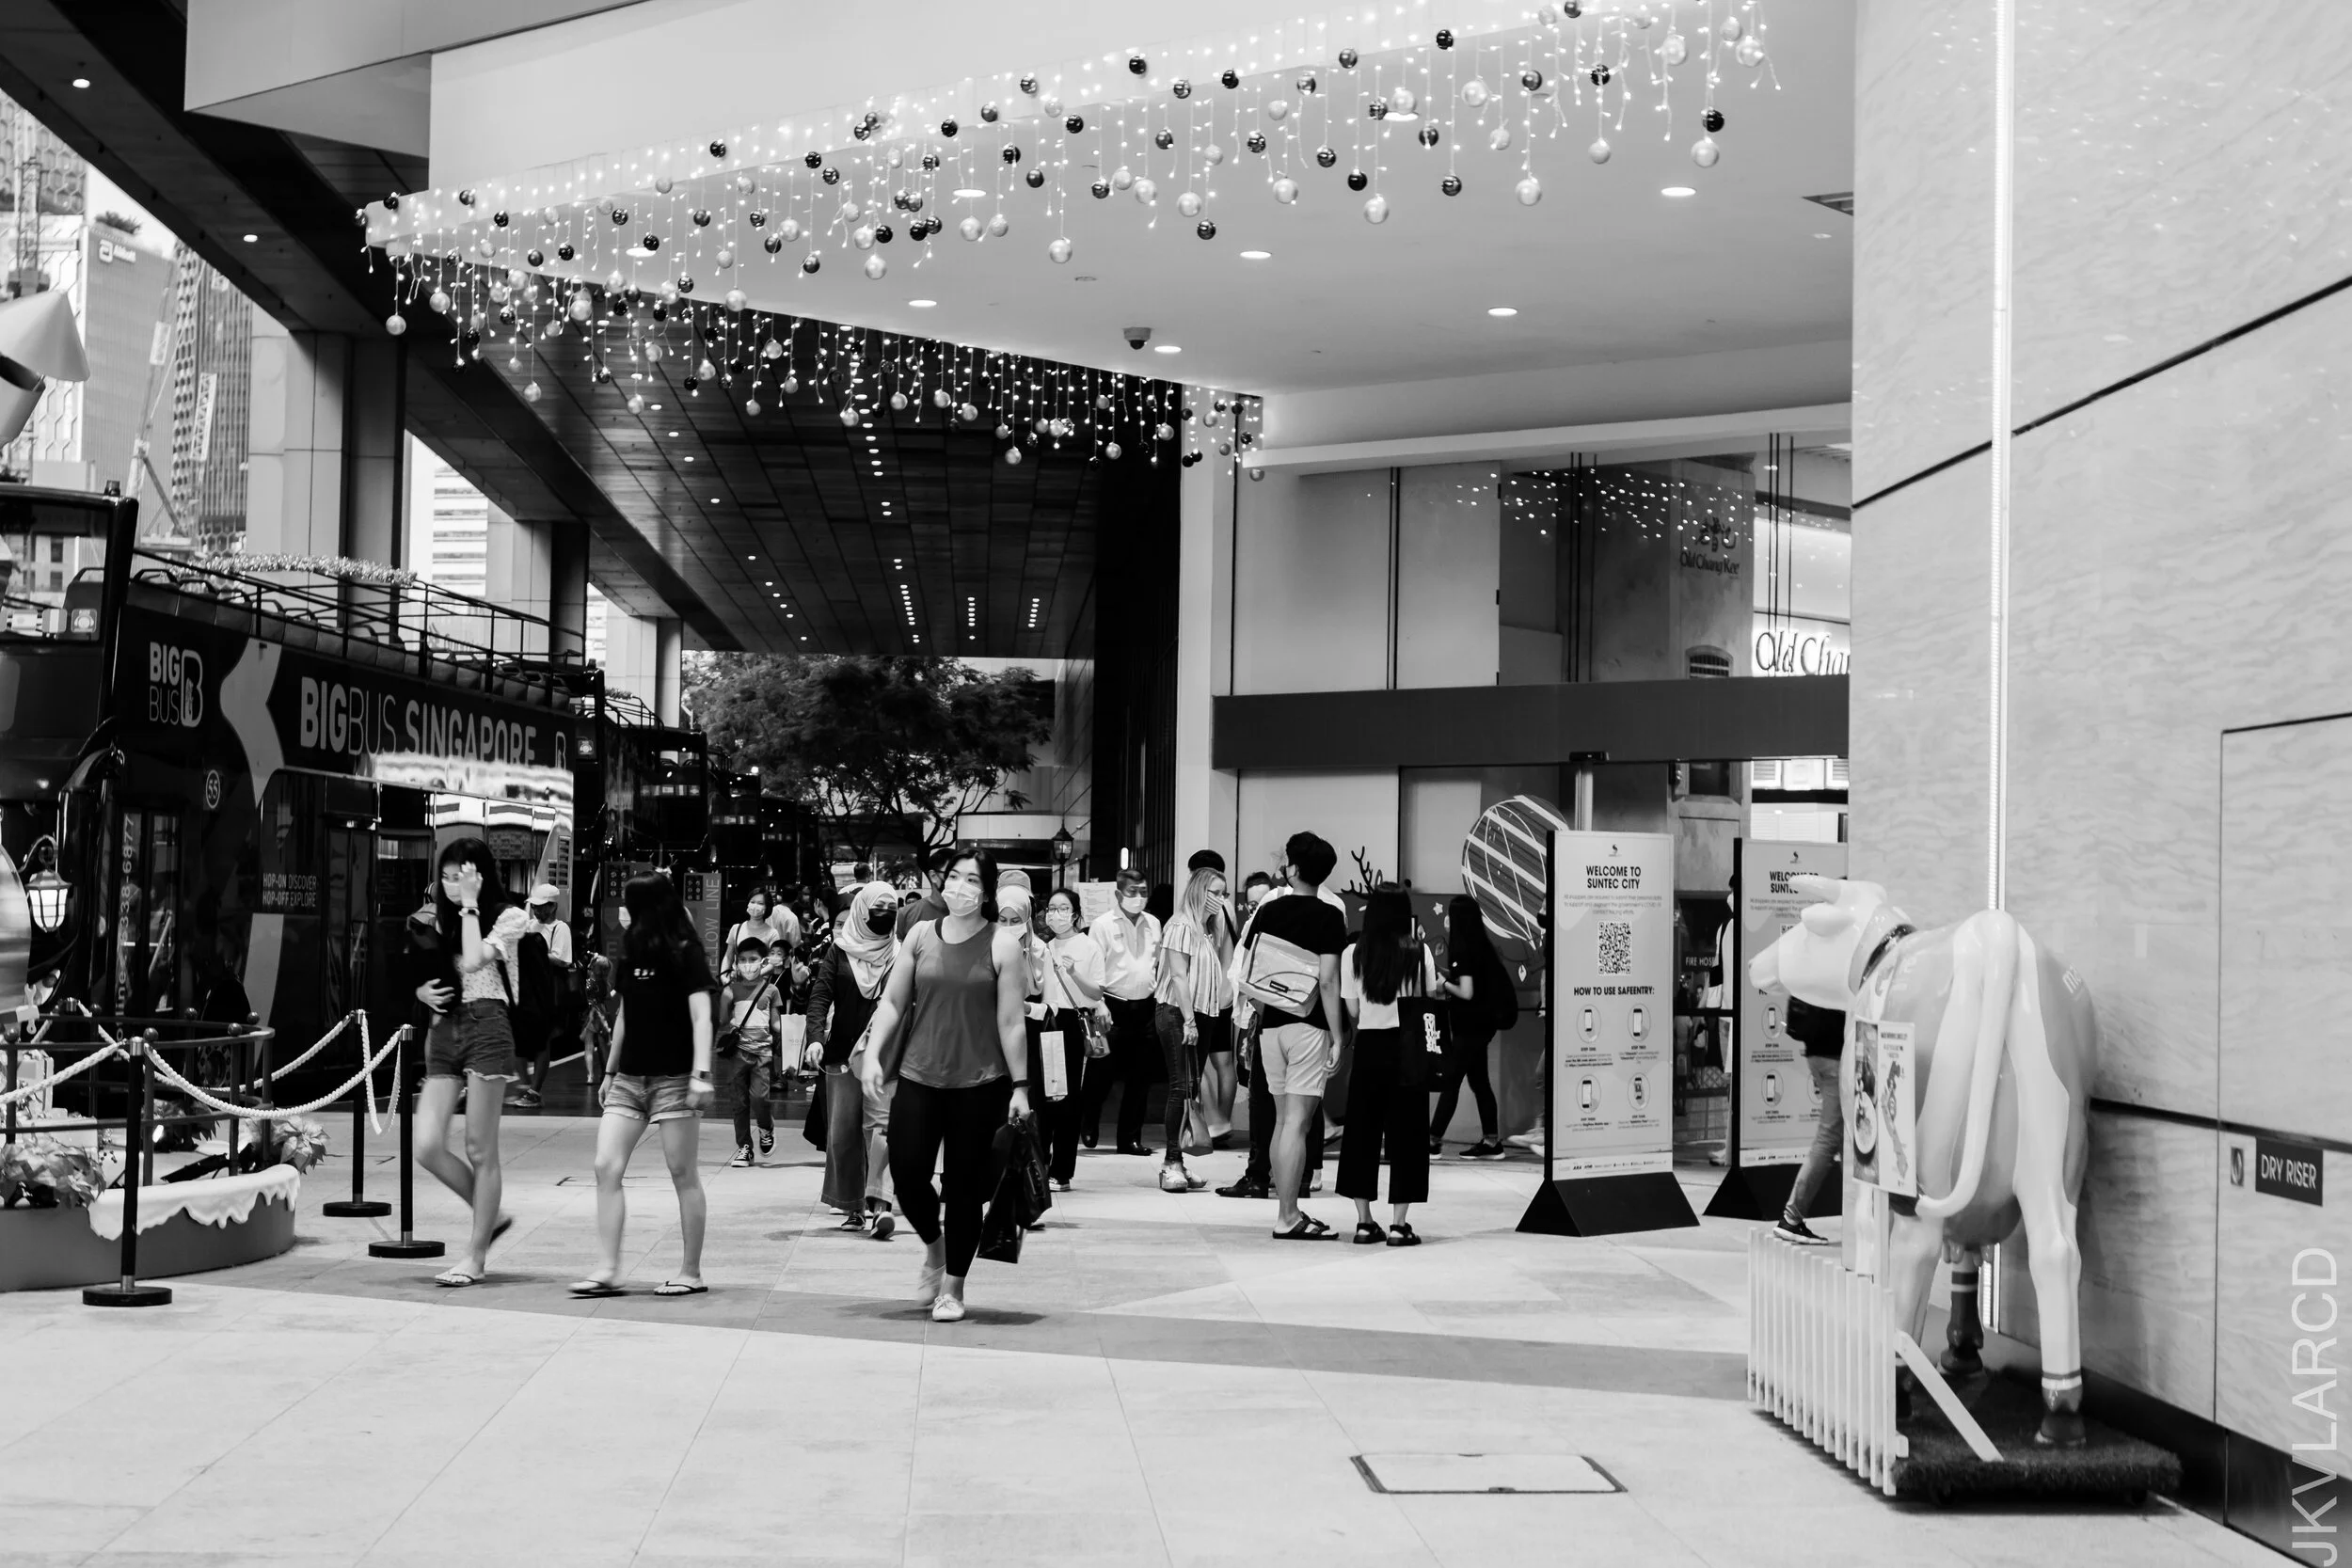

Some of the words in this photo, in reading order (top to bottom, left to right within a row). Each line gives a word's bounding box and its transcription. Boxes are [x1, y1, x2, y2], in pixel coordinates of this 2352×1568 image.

[1756, 630, 1798, 673] Old
[150, 641, 180, 686] BIG
[149, 685, 180, 726] BUS
[405, 699, 537, 766] SINGAPORE
[208, 779, 218, 800] 55
[1586, 865, 1628, 877] WELCOME
[1630, 866, 1641, 877] TO
[1770, 871, 1807, 881] WELC
[262, 873, 286, 889] HOP-ON
[288, 874, 317, 891] DISCOVER
[1587, 878, 1619, 889] SUNTEC
[1621, 879, 1641, 889] CITY
[262, 891, 289, 906] HOP-OFF
[290, 893, 316, 907] EXPLORE
[706, 879, 720, 910] LINE
[1685, 956, 1697, 966] FIRE
[1574, 987, 1592, 996] HOW
[1593, 987, 1602, 995] TO
[1604, 987, 1616, 995] USE
[1618, 986, 1655, 995] SAFEENTRY:
[2261, 1153, 2283, 1182] DRY
[2286, 1158, 2317, 1189] RISER
